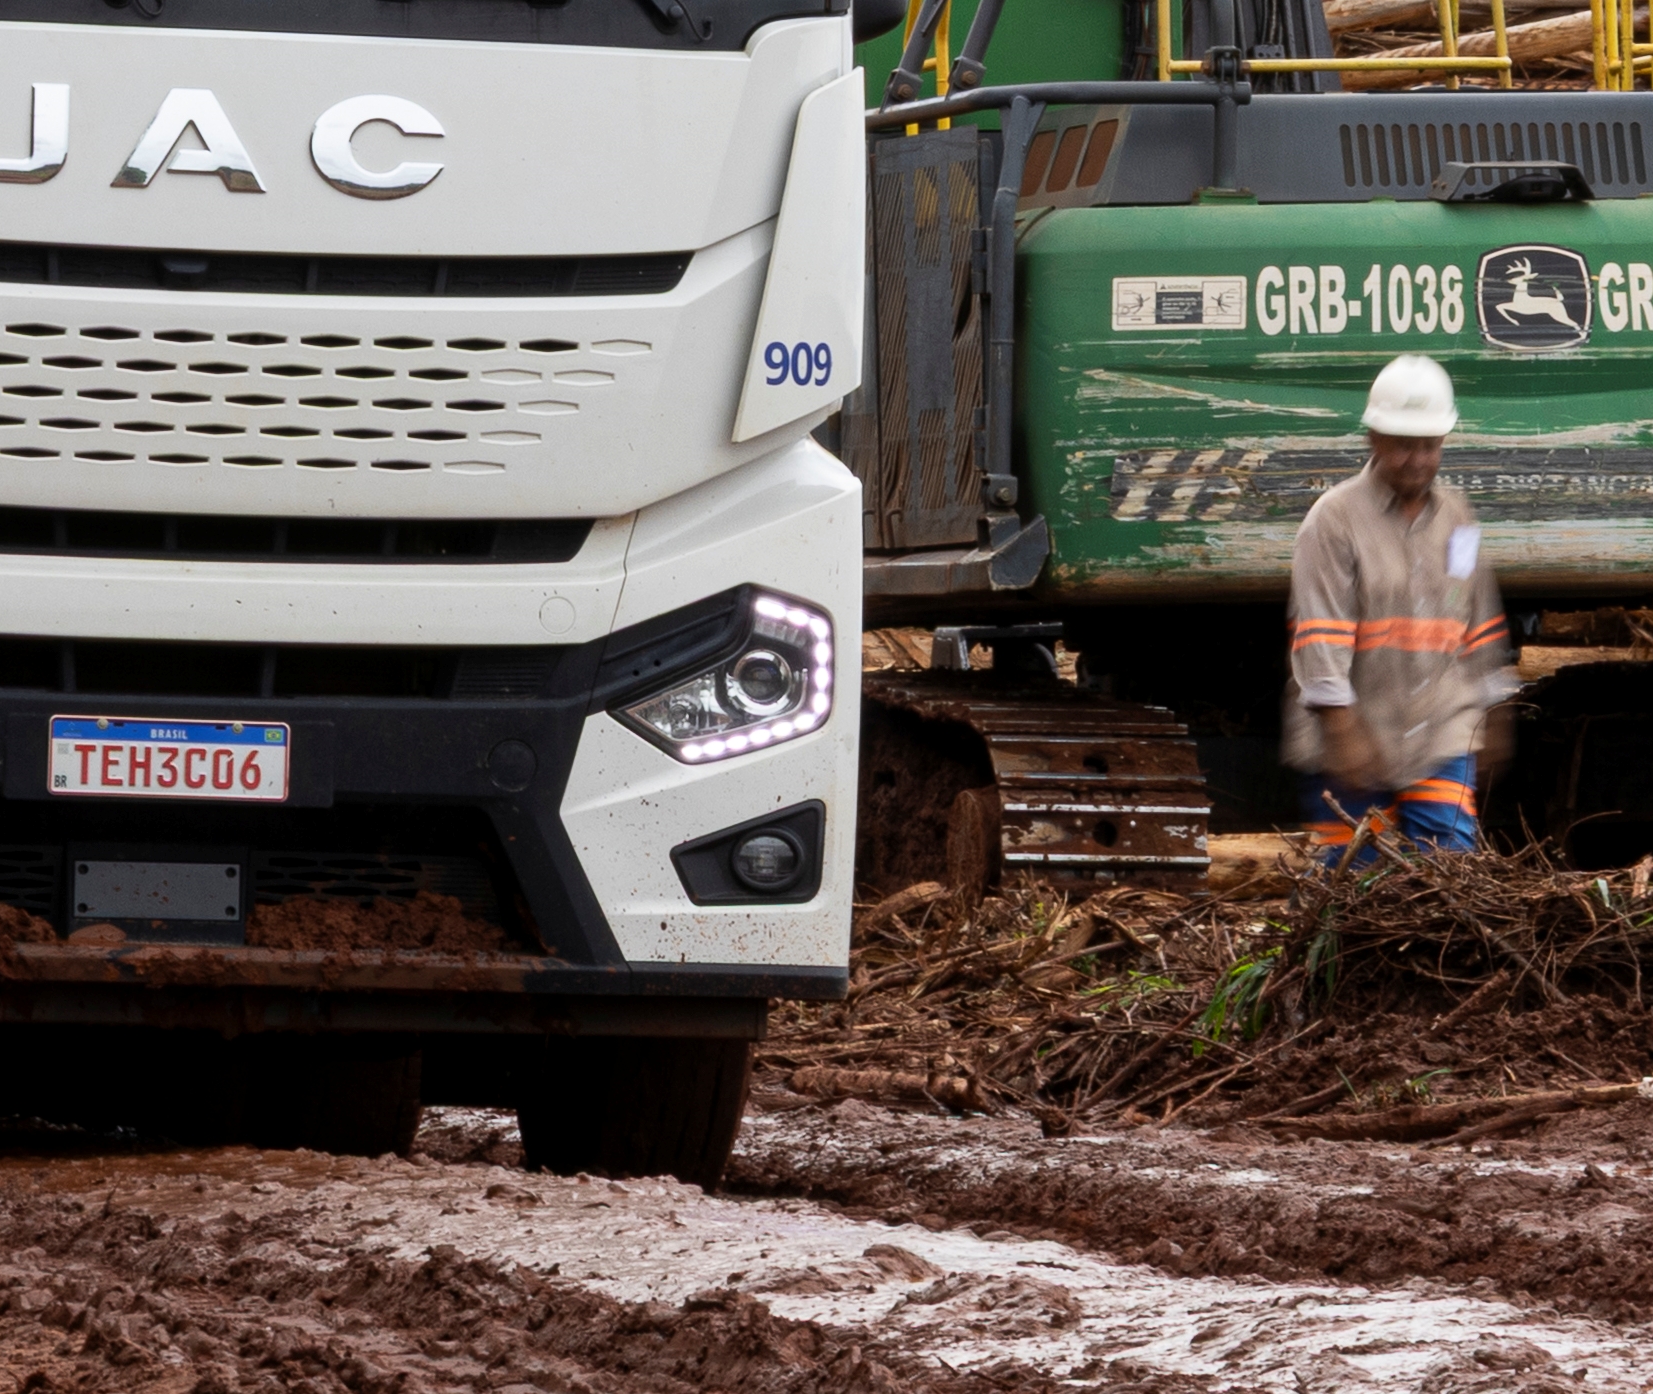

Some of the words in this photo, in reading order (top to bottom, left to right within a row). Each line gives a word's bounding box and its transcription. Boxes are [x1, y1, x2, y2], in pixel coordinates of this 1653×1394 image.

[1255, 264, 1465, 336] GRB-1038
[764, 341, 833, 387] 909
[150, 729, 188, 740] BRASIL
[54, 774, 67, 788] BR
[74, 744, 261, 790] TEH3C06
